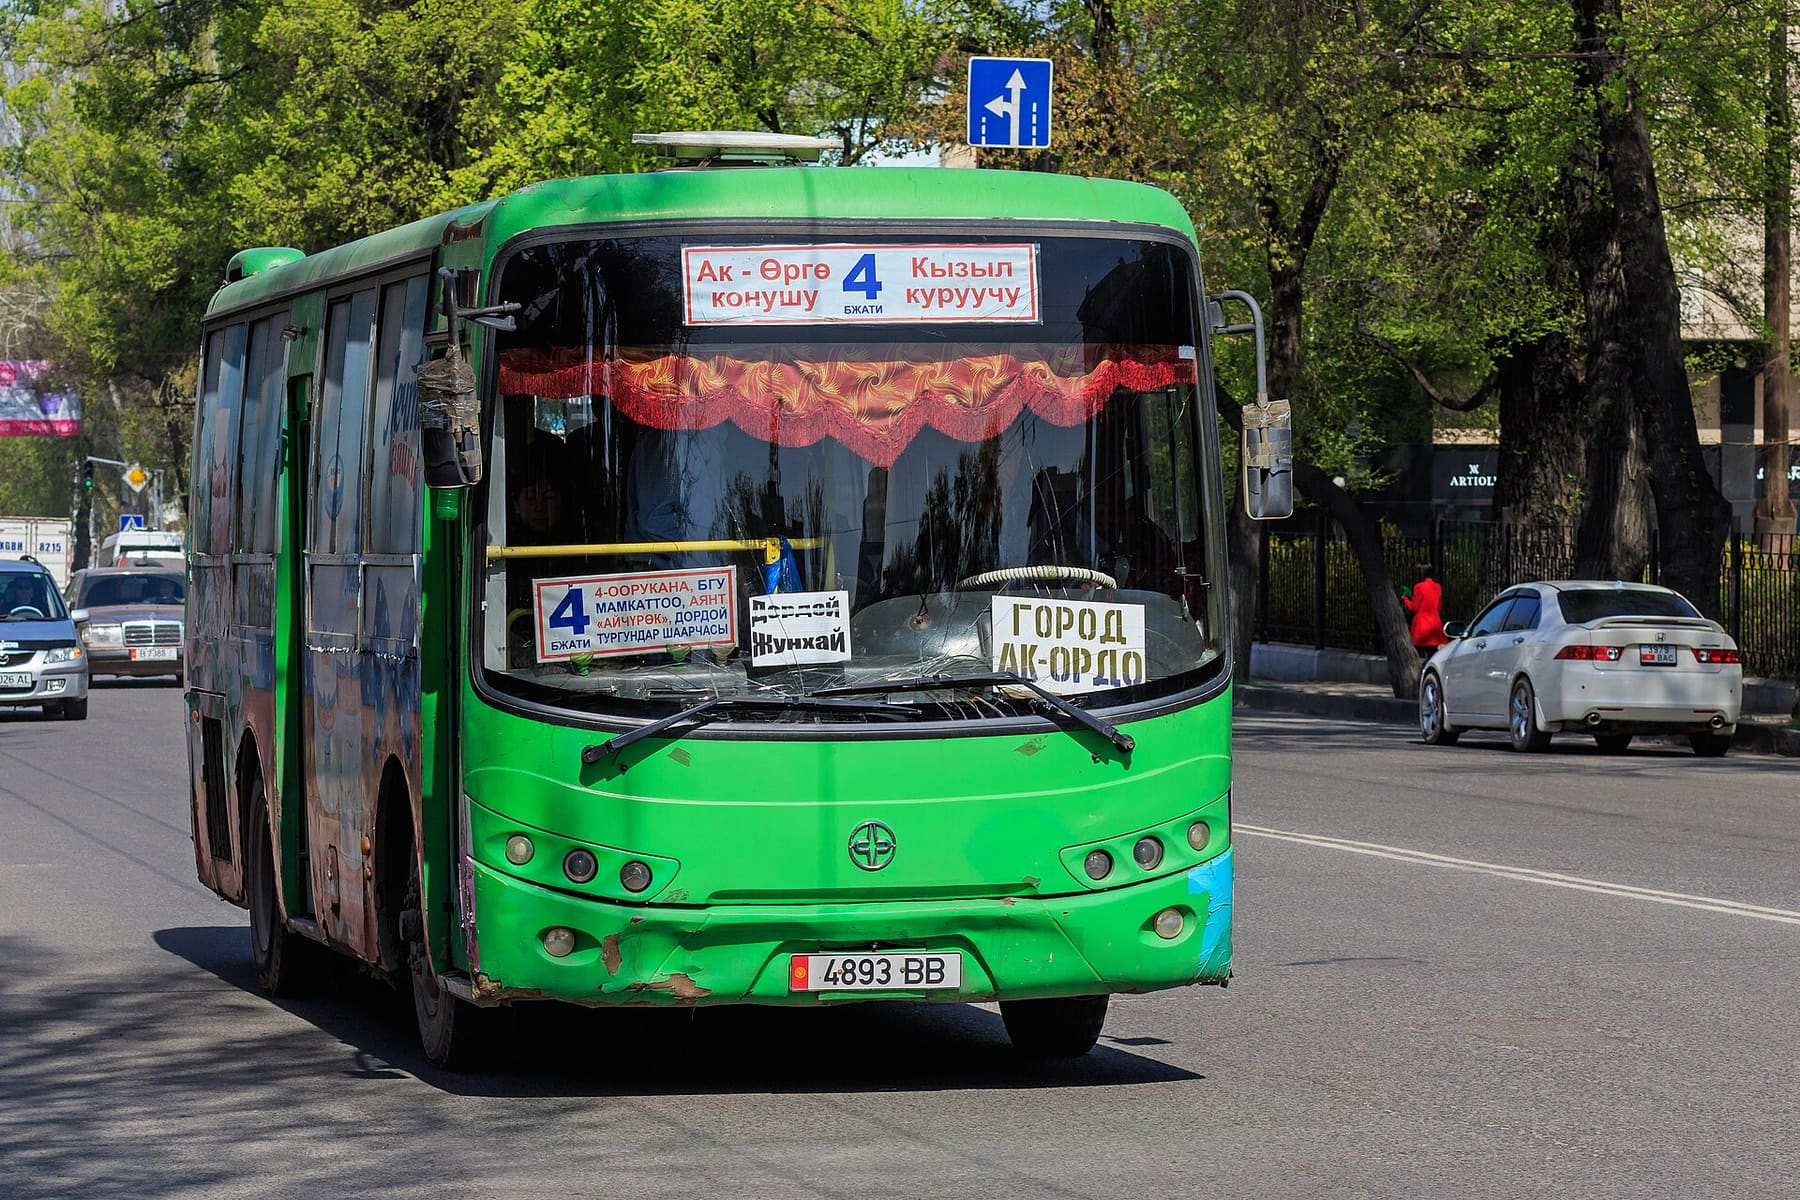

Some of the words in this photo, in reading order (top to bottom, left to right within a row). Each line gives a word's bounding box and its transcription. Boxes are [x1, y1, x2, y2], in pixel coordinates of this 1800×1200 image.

[697, 260, 733, 282] Ак
[760, 258, 831, 286] Өргө
[842, 253, 883, 300] 4
[911, 256, 1013, 279] Кызыл
[711, 288, 819, 313] конушу
[906, 285, 1020, 308] куруучу
[844, 305, 883, 315] БЖАТИ
[39, 542, 61, 552] 8215
[594, 581, 693, 598] 4-ООРУКАНА,
[698, 578, 726, 591] БГУ
[549, 587, 590, 636] 4
[596, 597, 685, 614] МАМКАТТОО,
[689, 593, 726, 607] АЯНТ
[675, 606, 728, 625] ДОРДОЙ
[1013, 603, 1127, 645] ГОРОД
[551, 638, 591, 651] БЖАТИ
[597, 628, 660, 645] ТУРГУНДАР
[663, 624, 728, 640] ШААРЧАСЫ
[998, 642, 1143, 688] АК-ОРДО
[823, 957, 892, 986] 4893
[904, 957, 945, 985] BB
